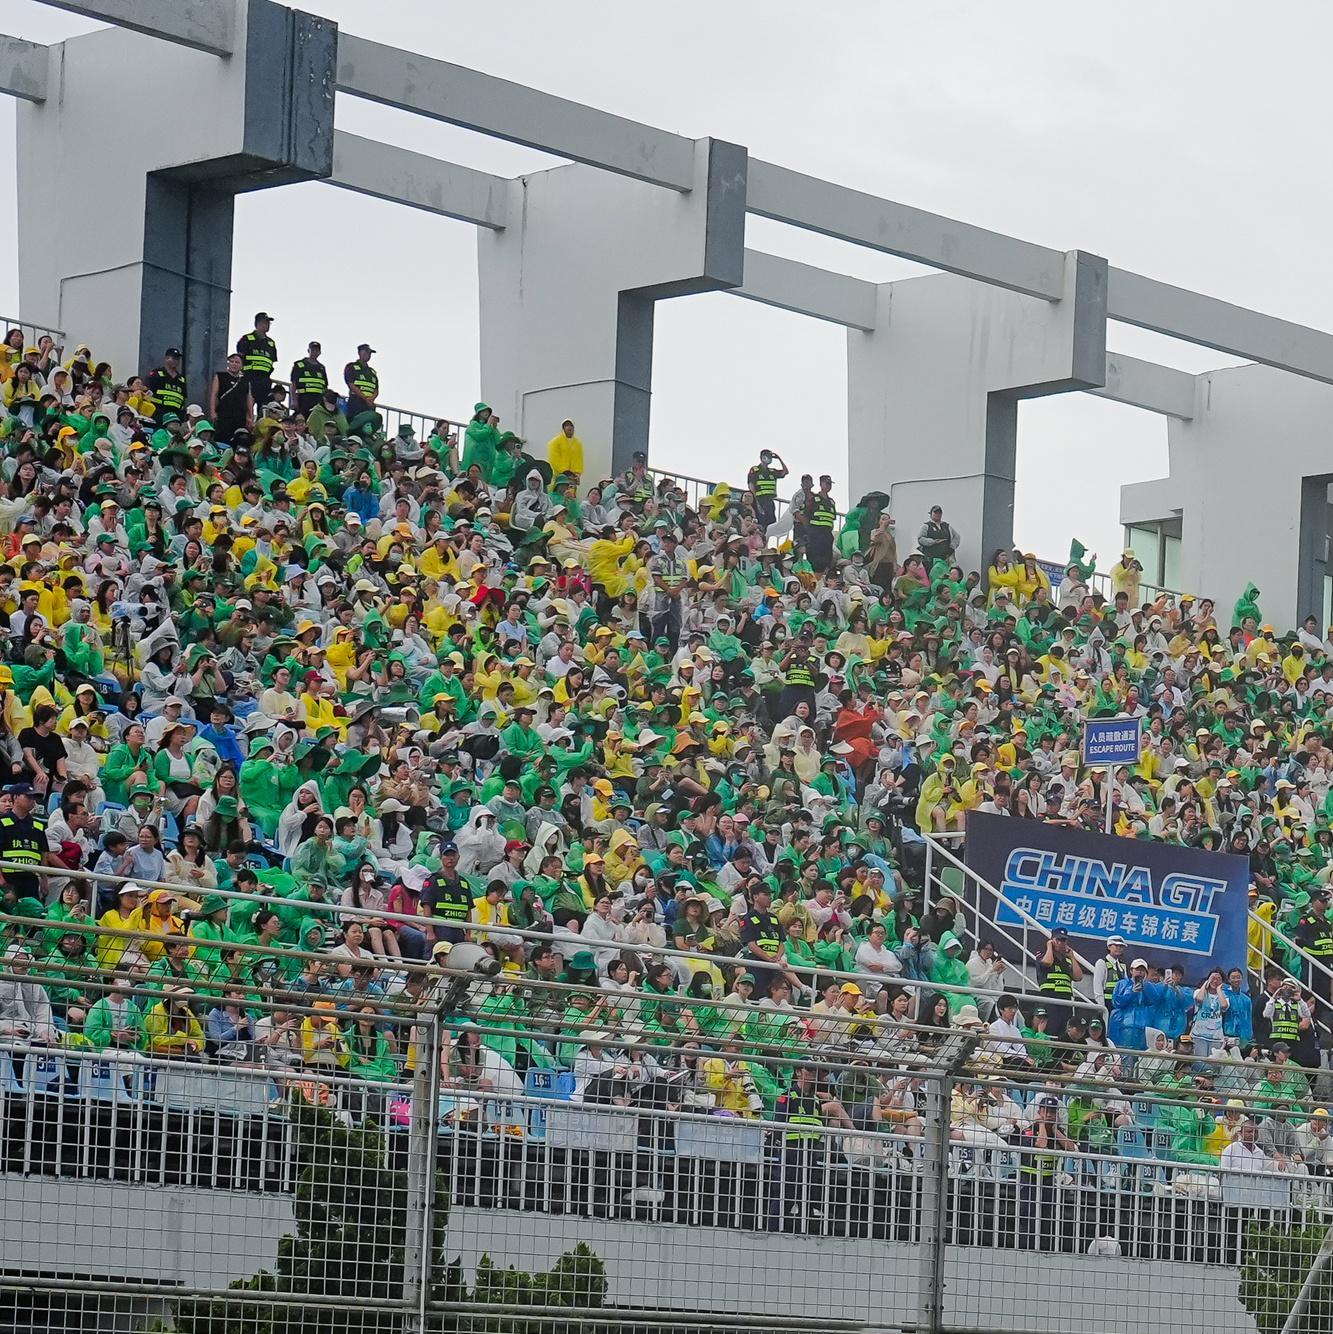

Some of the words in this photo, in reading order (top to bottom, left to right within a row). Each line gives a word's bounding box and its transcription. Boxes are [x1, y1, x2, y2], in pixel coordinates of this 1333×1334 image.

[1090, 745, 1113, 754] ESCAPE
[1115, 743, 1136, 752] ROUTE
[1005, 848, 1154, 906] CHINA
[1160, 872, 1228, 914] GT
[1015, 895, 1201, 944] 中国超级跑车锦标赛
